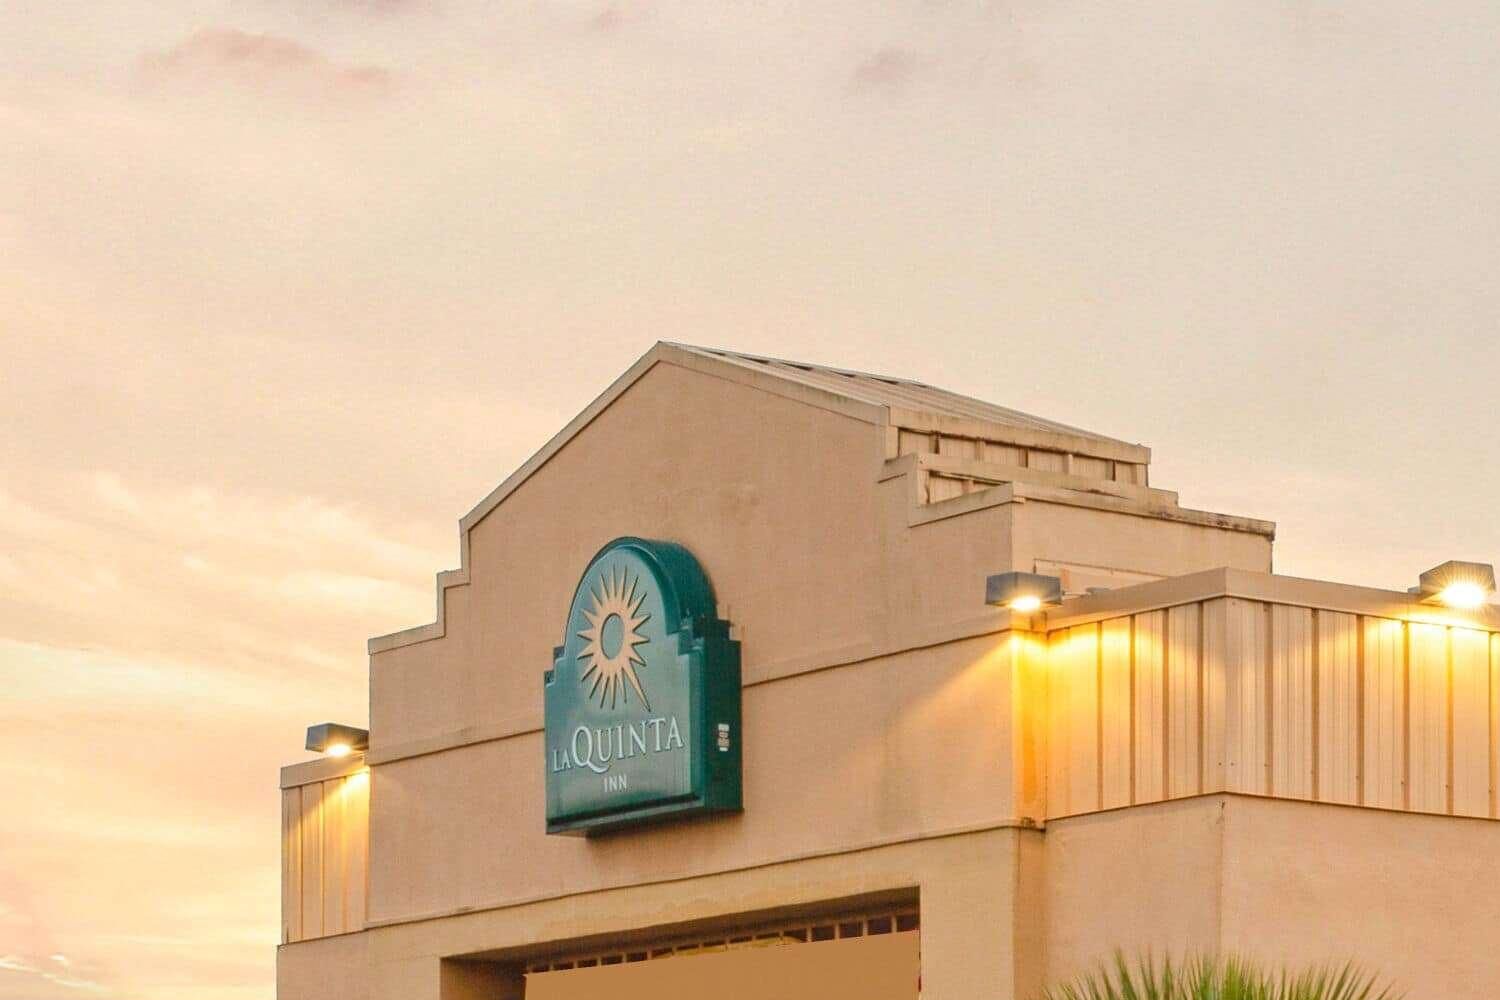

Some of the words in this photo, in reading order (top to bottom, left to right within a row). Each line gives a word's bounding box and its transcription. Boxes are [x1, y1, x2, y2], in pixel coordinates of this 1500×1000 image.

[553, 748, 573, 772] LA
[572, 716, 684, 773] QUINTA
[603, 774, 627, 793] INN
